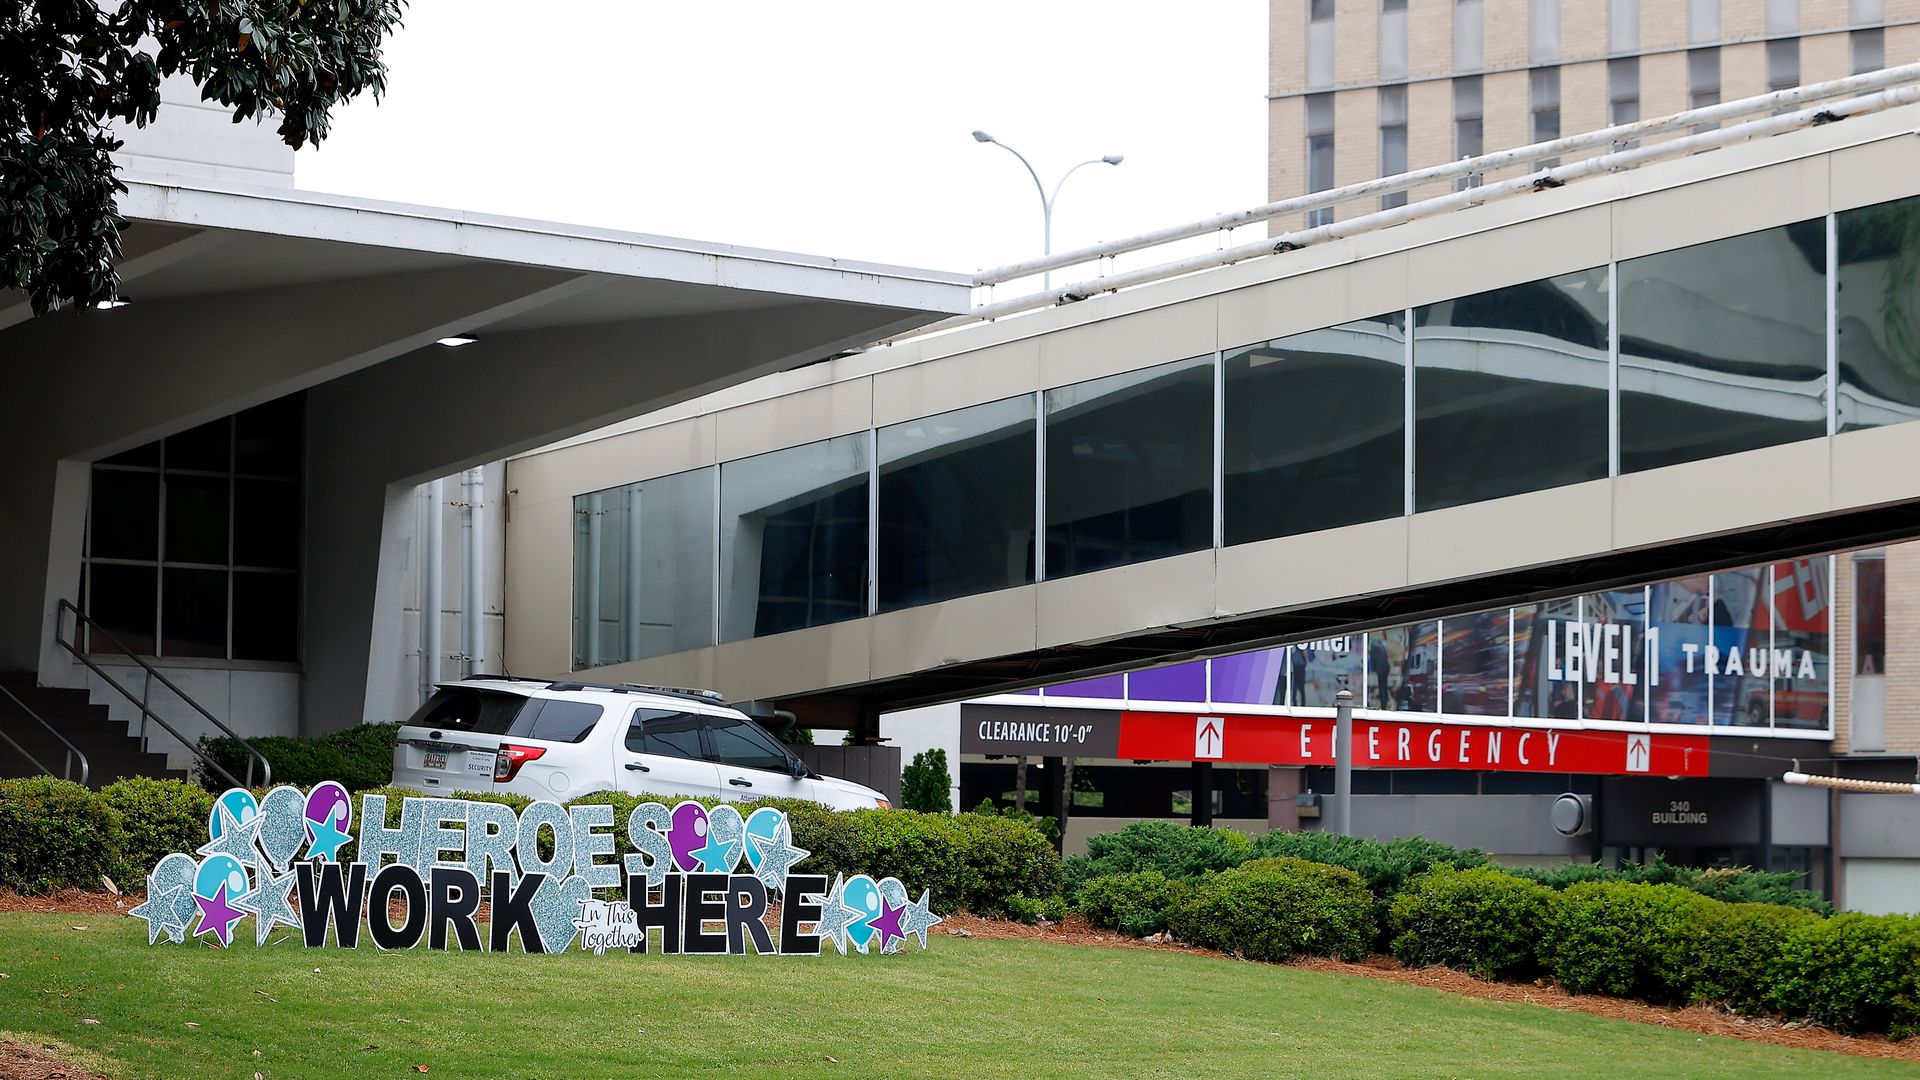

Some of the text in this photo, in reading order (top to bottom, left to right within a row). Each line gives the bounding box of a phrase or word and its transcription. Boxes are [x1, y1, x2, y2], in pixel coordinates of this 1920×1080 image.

[1548, 620, 1817, 686] LEVEL 1 TRAUMA
[979, 721, 1050, 742] CLEARANCE
[1300, 724, 1560, 766] EERGENCY
[468, 764, 493, 772] SECURITY
[1652, 812, 1708, 824] BUILDING
[1670, 801, 1690, 812] 340
[357, 794, 674, 887] HEROES
[295, 862, 829, 956] WORK HERE
[573, 900, 634, 926] In This
[579, 924, 643, 955] Together
